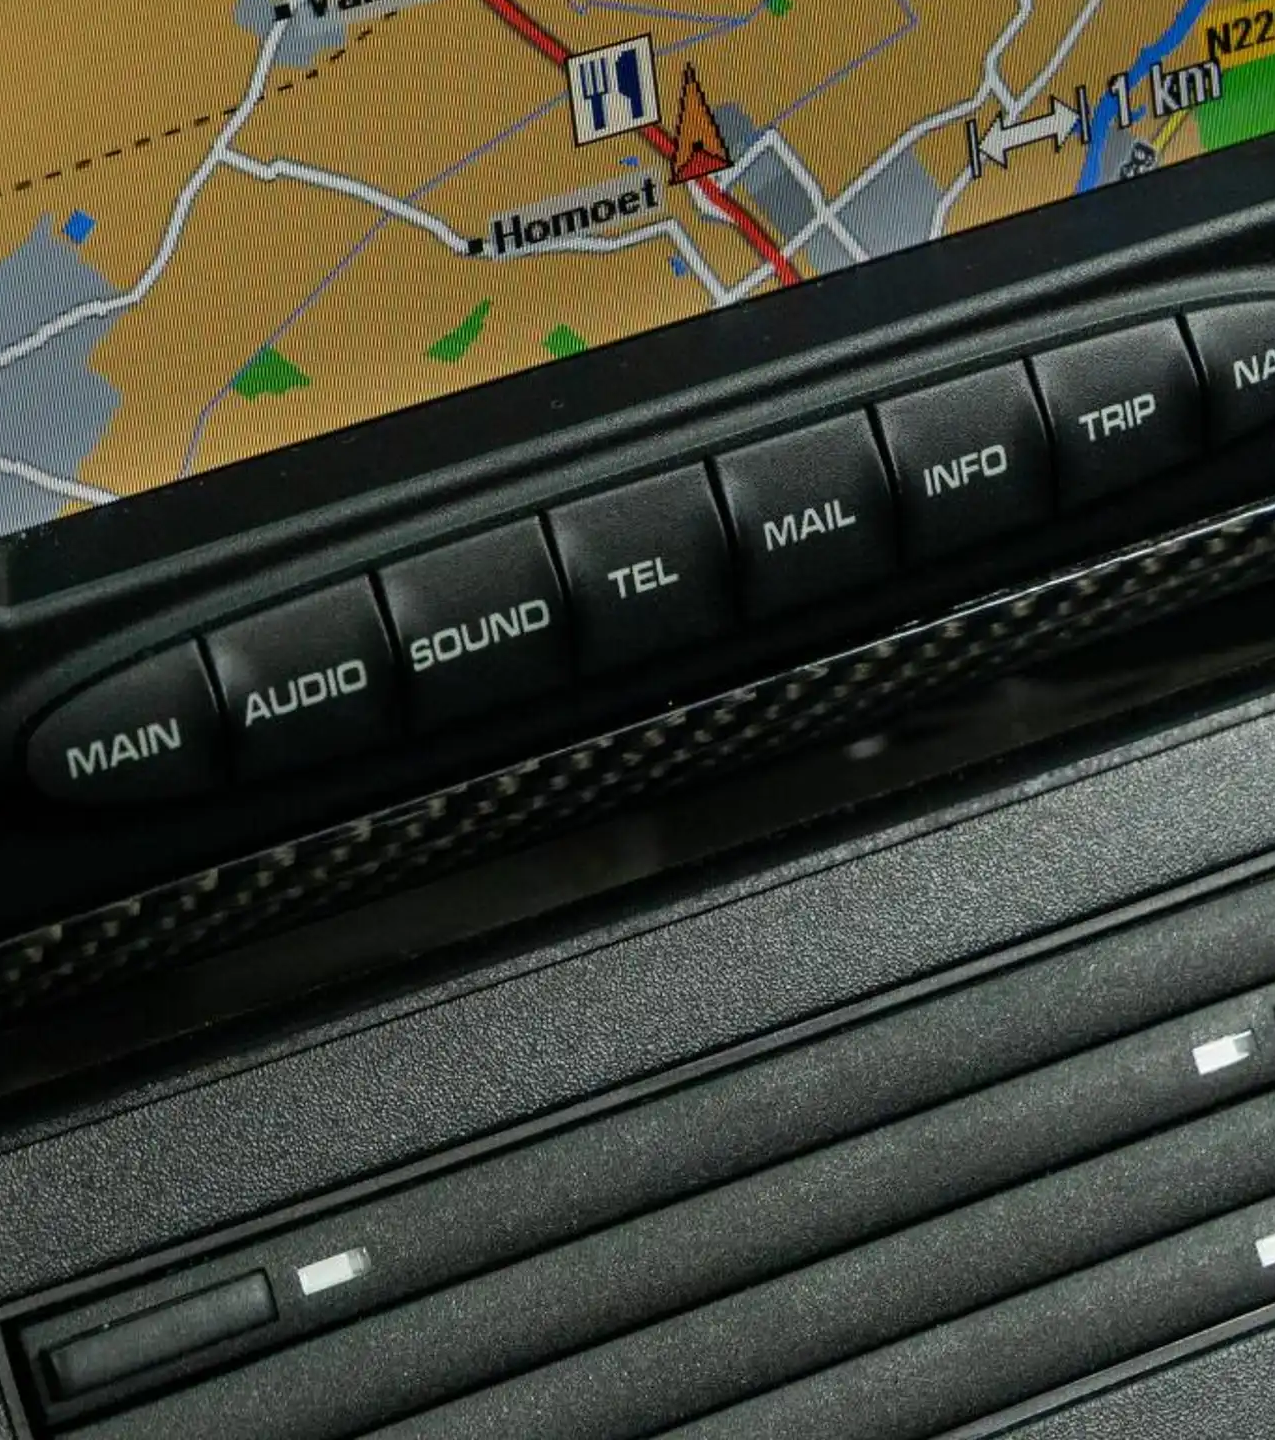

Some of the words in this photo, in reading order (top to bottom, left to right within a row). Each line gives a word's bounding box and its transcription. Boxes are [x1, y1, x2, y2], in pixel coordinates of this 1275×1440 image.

[1109, 74, 1132, 130] 1
[1150, 60, 1223, 119] km
[492, 177, 660, 257] Homoet
[1079, 394, 1157, 444] TRIP
[923, 443, 1009, 498] INFO
[762, 496, 856, 552] MAIL
[608, 556, 681, 601] TEL
[409, 598, 551, 672] SOUND
[243, 658, 368, 727] AUDIO
[65, 718, 182, 781] MAIN
